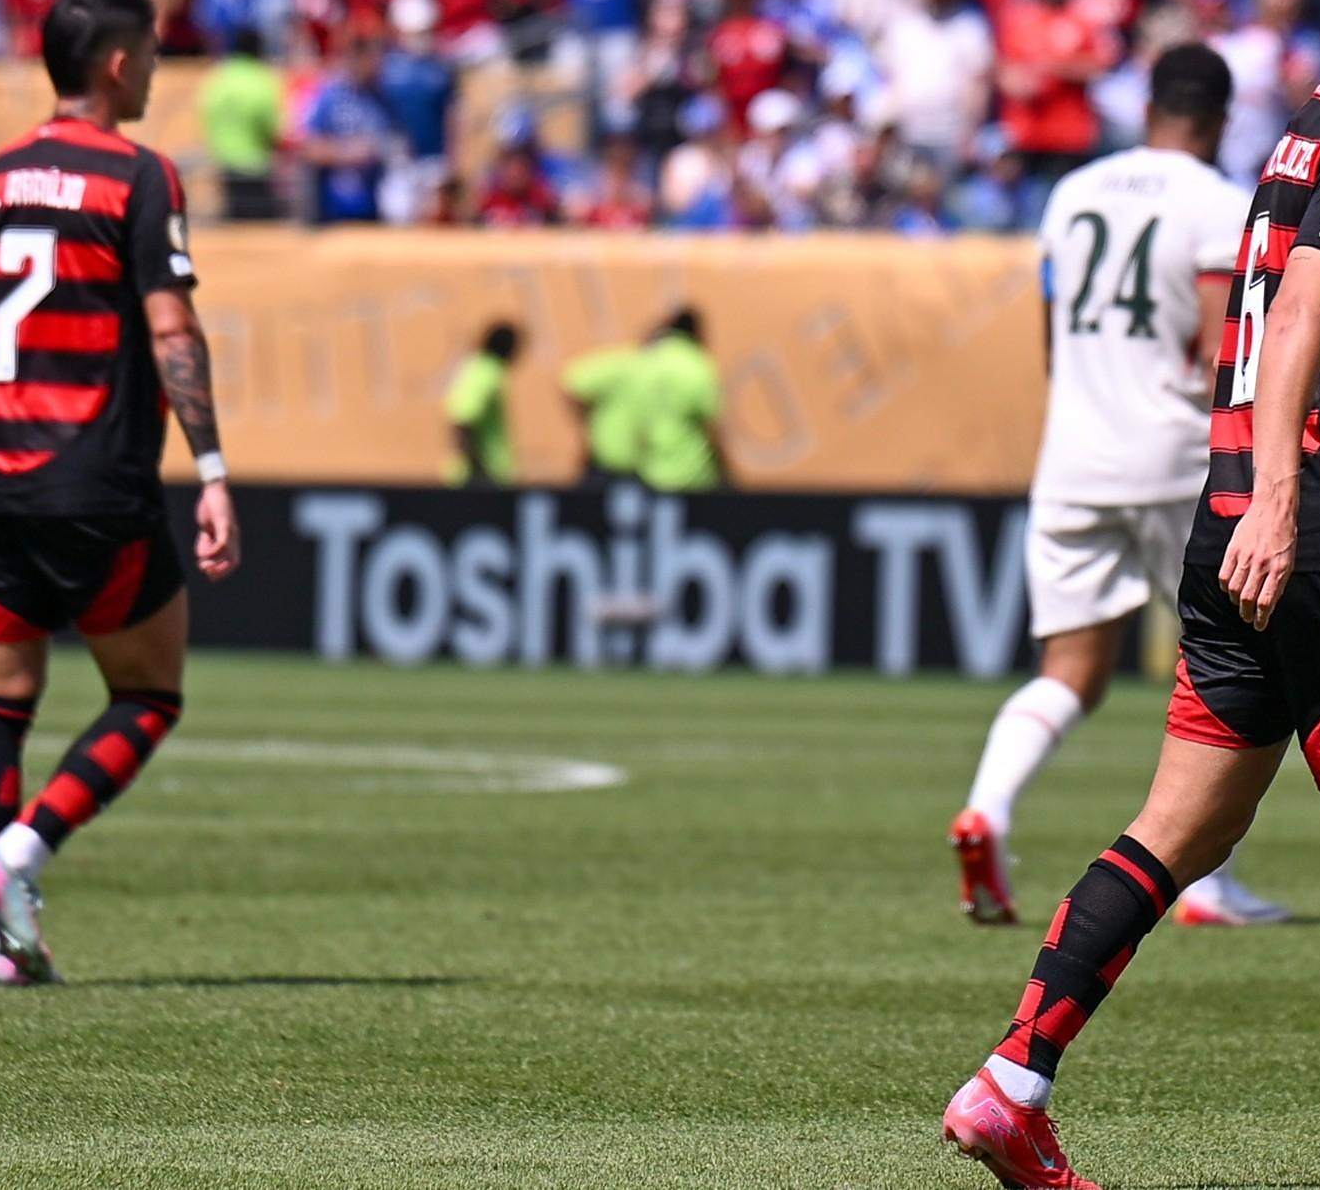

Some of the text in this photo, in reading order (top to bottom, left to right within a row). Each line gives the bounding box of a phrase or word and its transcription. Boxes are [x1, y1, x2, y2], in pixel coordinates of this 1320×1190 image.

[1068, 210, 1160, 338] 24
[1230, 210, 1271, 408] 6
[290, 483, 834, 671] Toshiba
[852, 495, 1036, 679] TV
